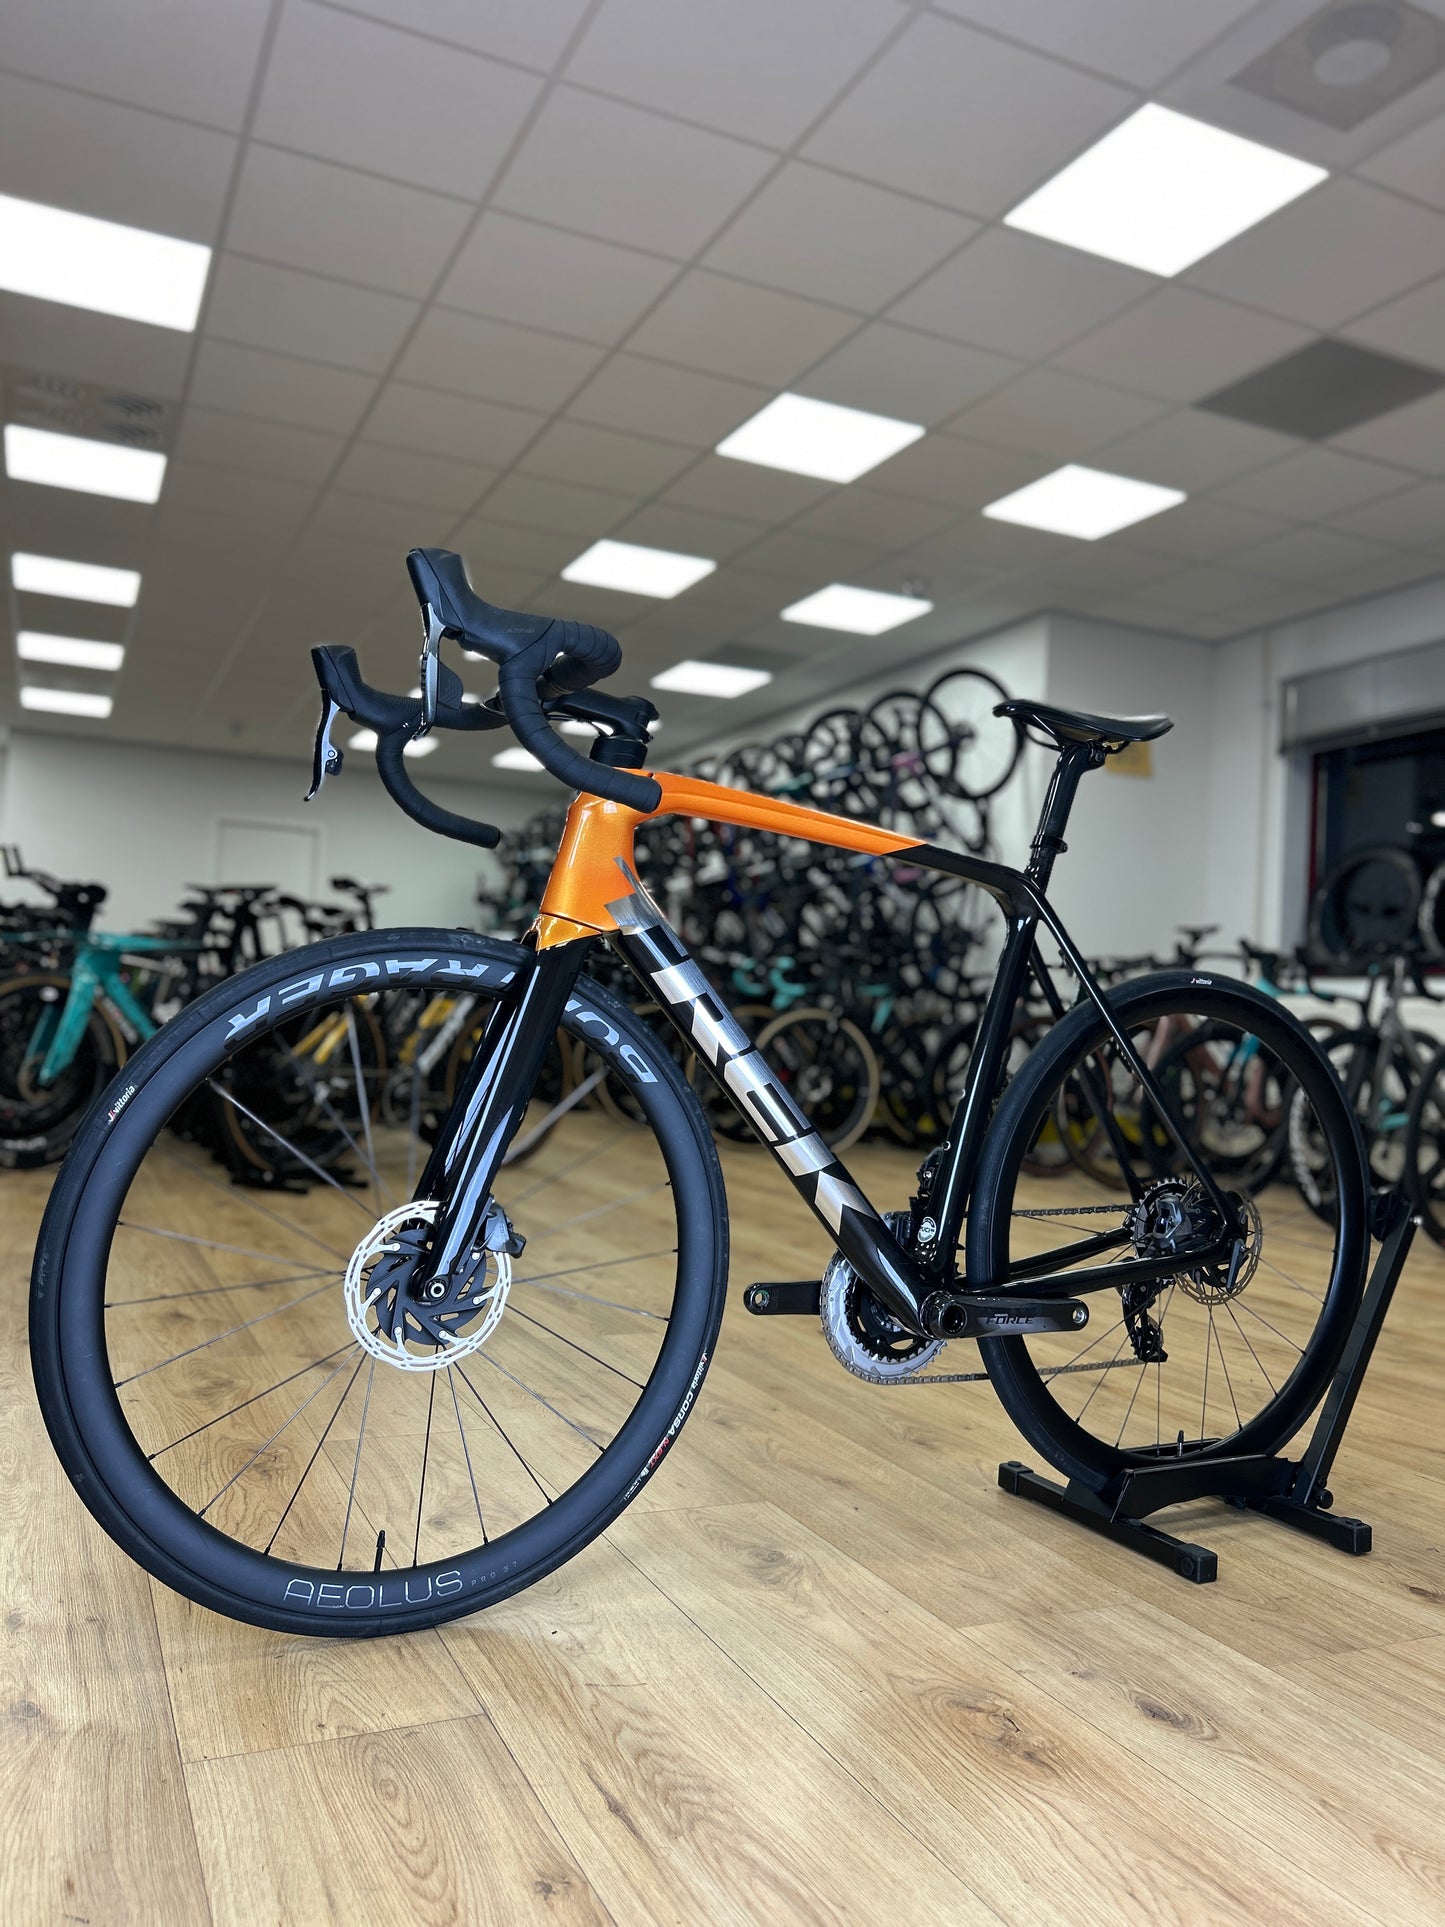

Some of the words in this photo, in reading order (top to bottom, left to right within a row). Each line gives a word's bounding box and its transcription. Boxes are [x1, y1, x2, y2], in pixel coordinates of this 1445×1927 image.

[606, 856, 879, 1235] TREK
[113, 1085, 135, 1113] vittoria
[985, 1316, 1034, 1325] FORCE
[668, 1390, 694, 1436] CORSA
[283, 1570, 463, 1609] AEOLUS
[471, 1571, 496, 1586] PRO
